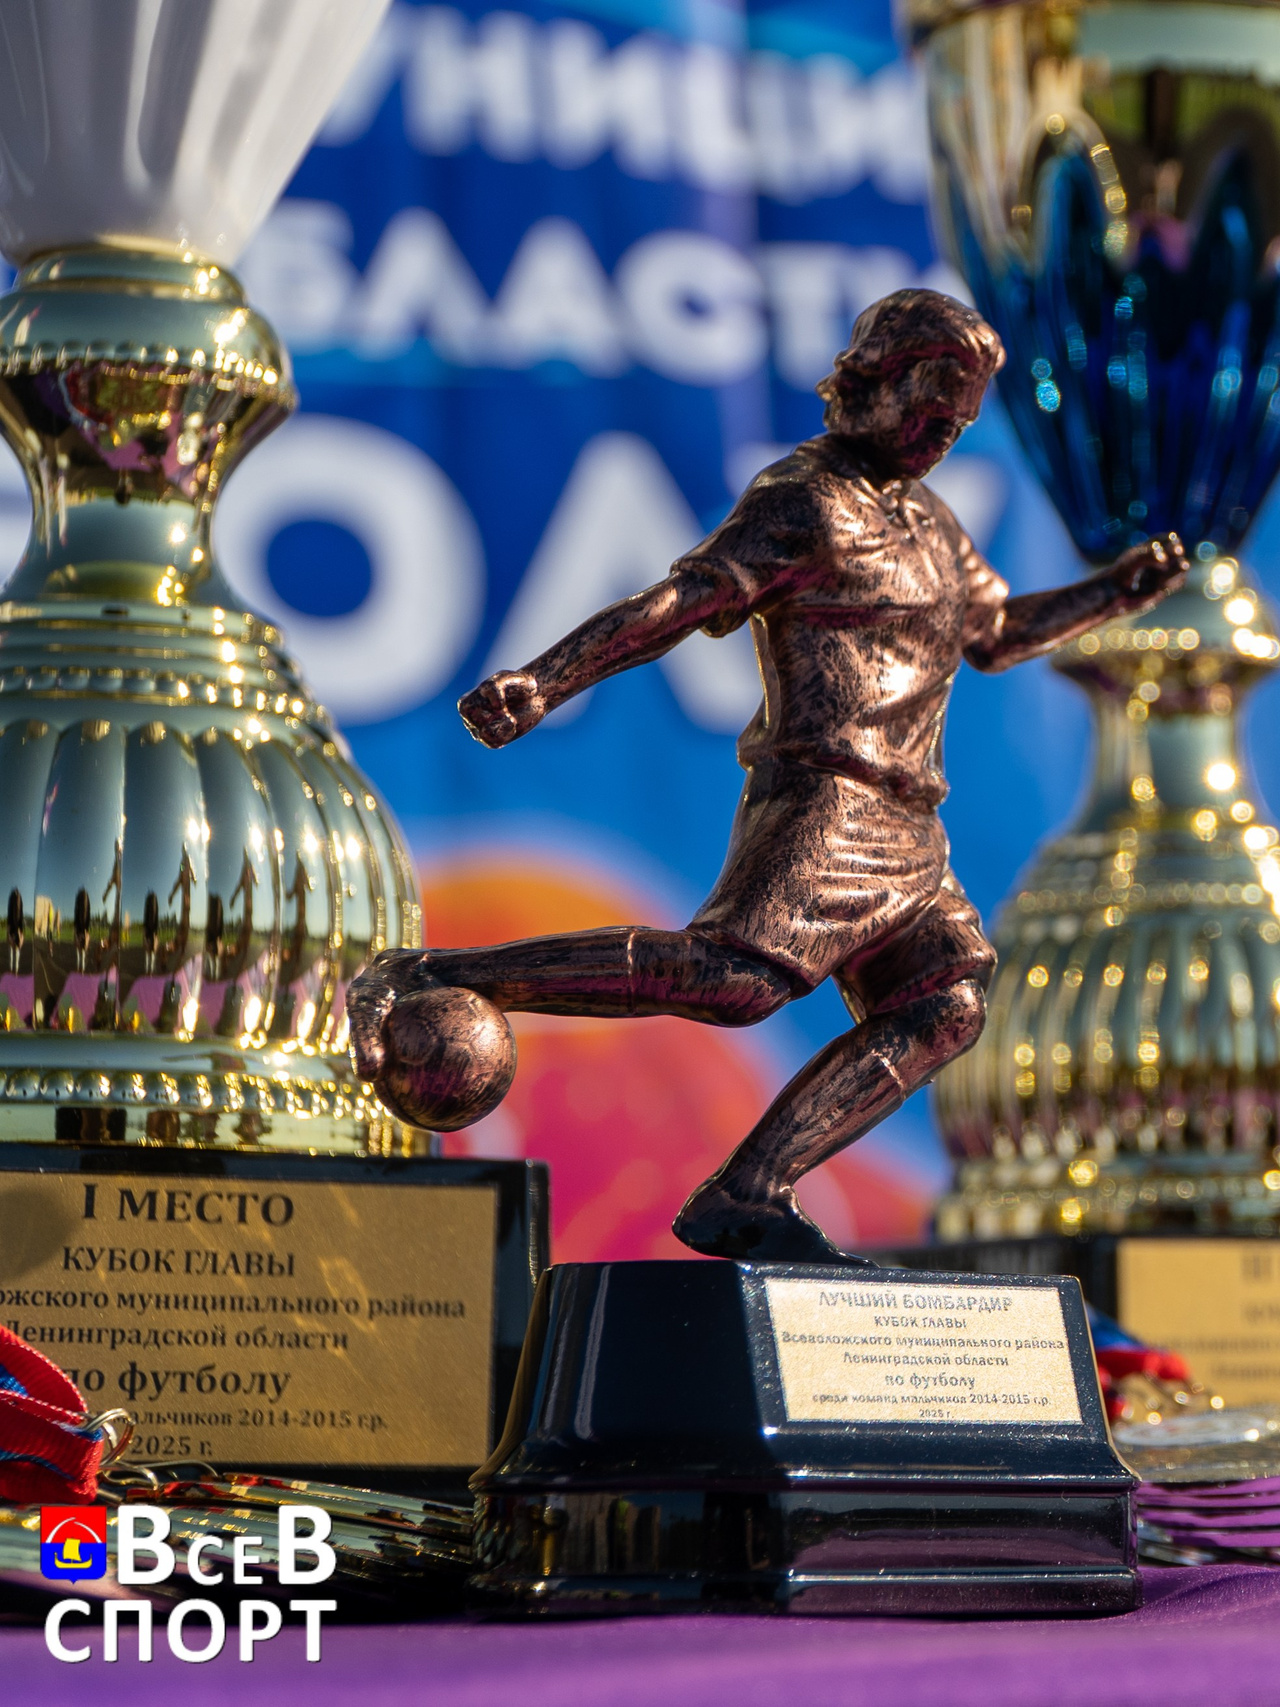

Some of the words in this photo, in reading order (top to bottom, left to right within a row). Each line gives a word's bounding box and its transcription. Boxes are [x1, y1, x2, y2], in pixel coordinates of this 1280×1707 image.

[236, 200, 972, 386] БЛАСТ
[118, 1188, 294, 1226] МЕСТО
[63, 1246, 175, 1274] КУБОК
[184, 1250, 295, 1277] ГЛАВЫ
[117, 1292, 360, 1318] муниципального
[367, 1295, 466, 1320] района
[819, 1290, 898, 1308] ЛУЧШИЙ
[902, 1294, 1012, 1313] БОМБАРДИР
[874, 1315, 919, 1328] КУБОК
[922, 1317, 967, 1329] ГЛАВЫ
[7, 1320, 226, 1350] Ленинградской
[234, 1324, 349, 1350] области
[782, 1331, 892, 1346] Всеволожского
[896, 1337, 1011, 1351] муниципального
[1015, 1337, 1065, 1351] района
[843, 1352, 951, 1366] Ленинградской
[955, 1354, 1009, 1366] области
[118, 1361, 291, 1404] футболу
[885, 1375, 905, 1386] по
[910, 1373, 975, 1390] футболу
[238, 1410, 351, 1429] 2014-2015
[131, 1435, 191, 1456] 2025
